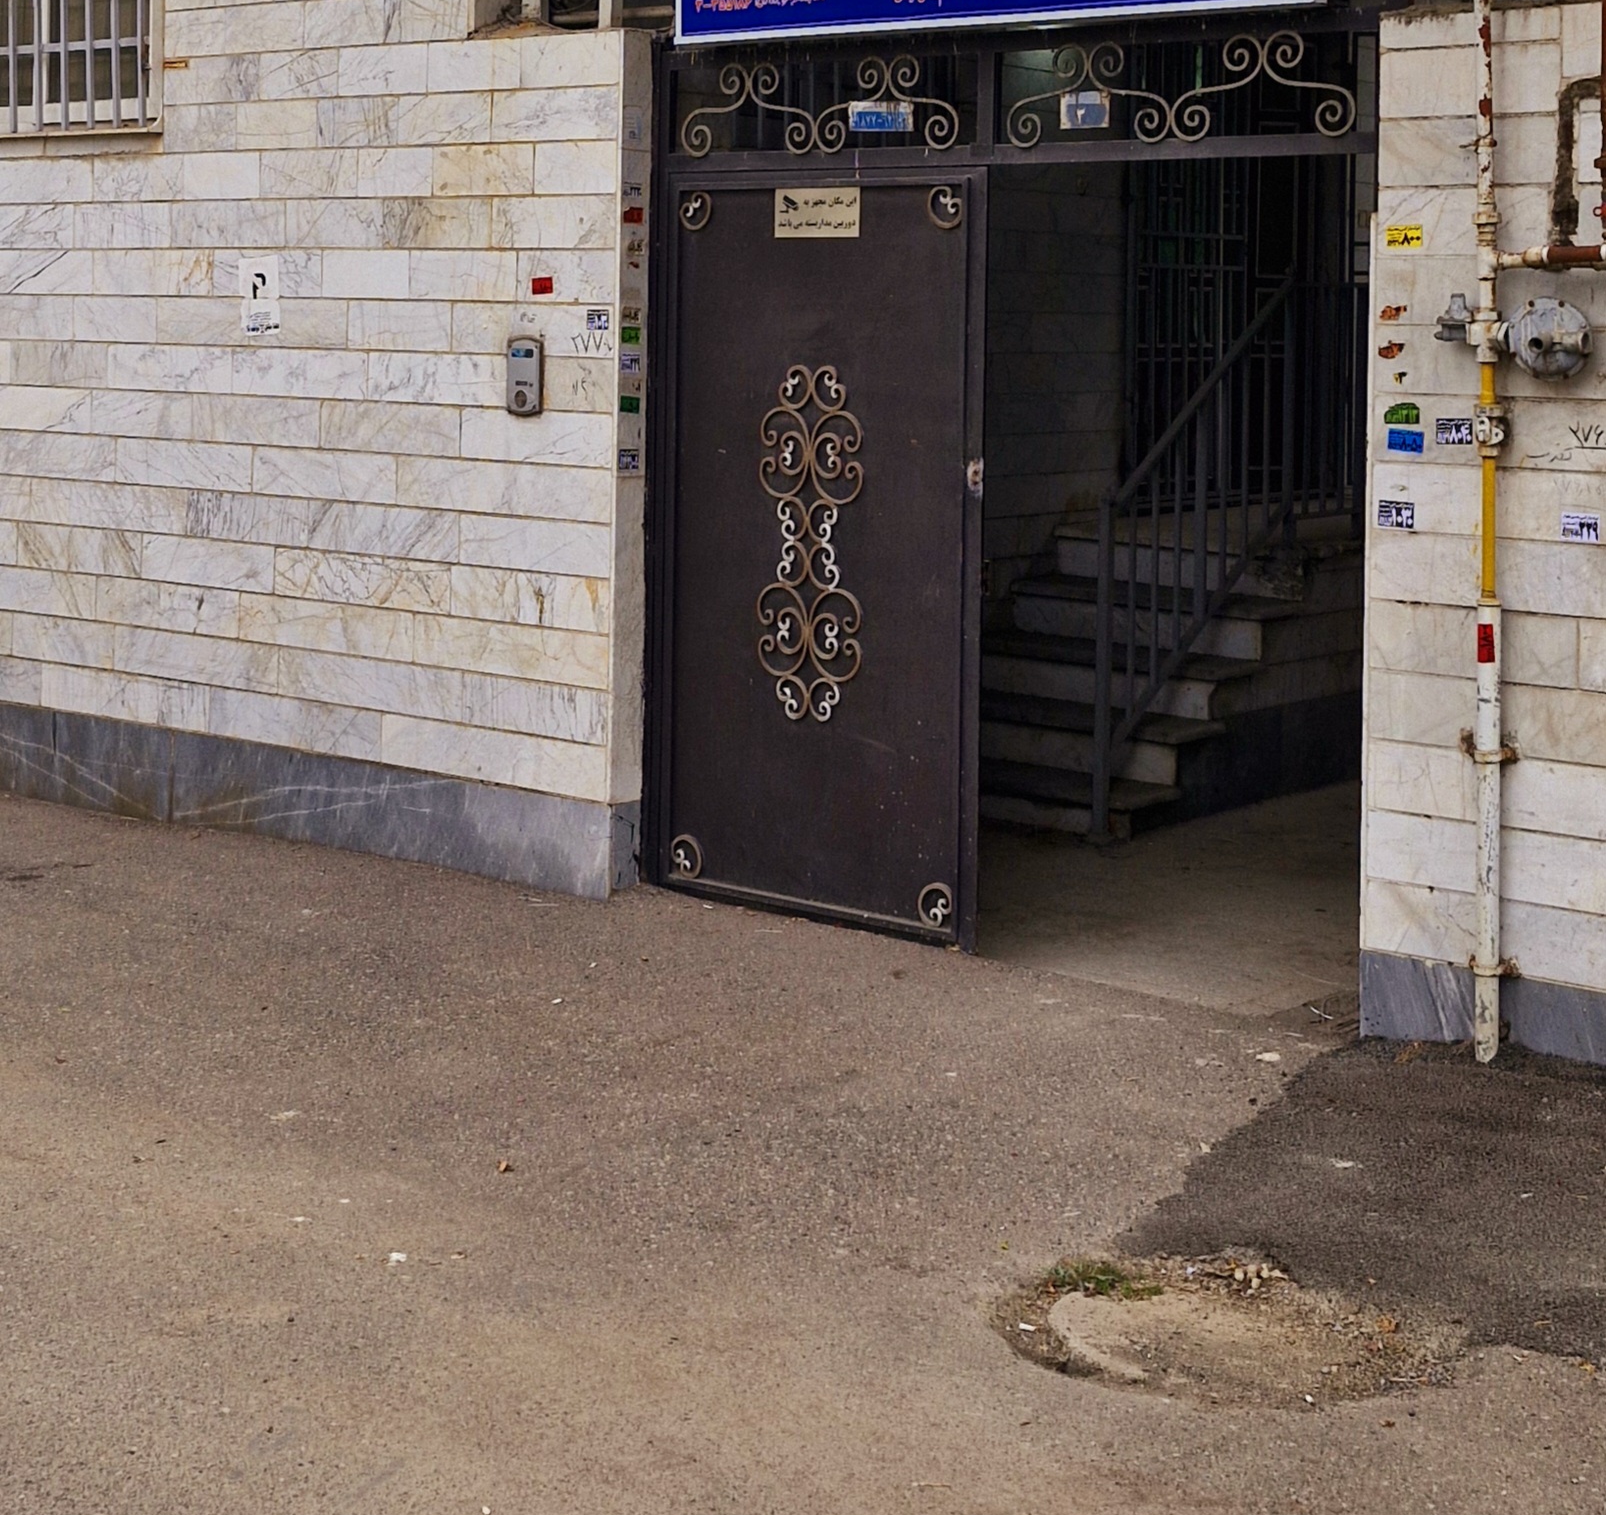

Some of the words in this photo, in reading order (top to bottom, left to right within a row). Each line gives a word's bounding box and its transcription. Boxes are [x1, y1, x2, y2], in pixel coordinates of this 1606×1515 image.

[828, 196, 844, 208] مکان
[845, 196, 857, 207] این
[832, 219, 857, 230] دوربین
